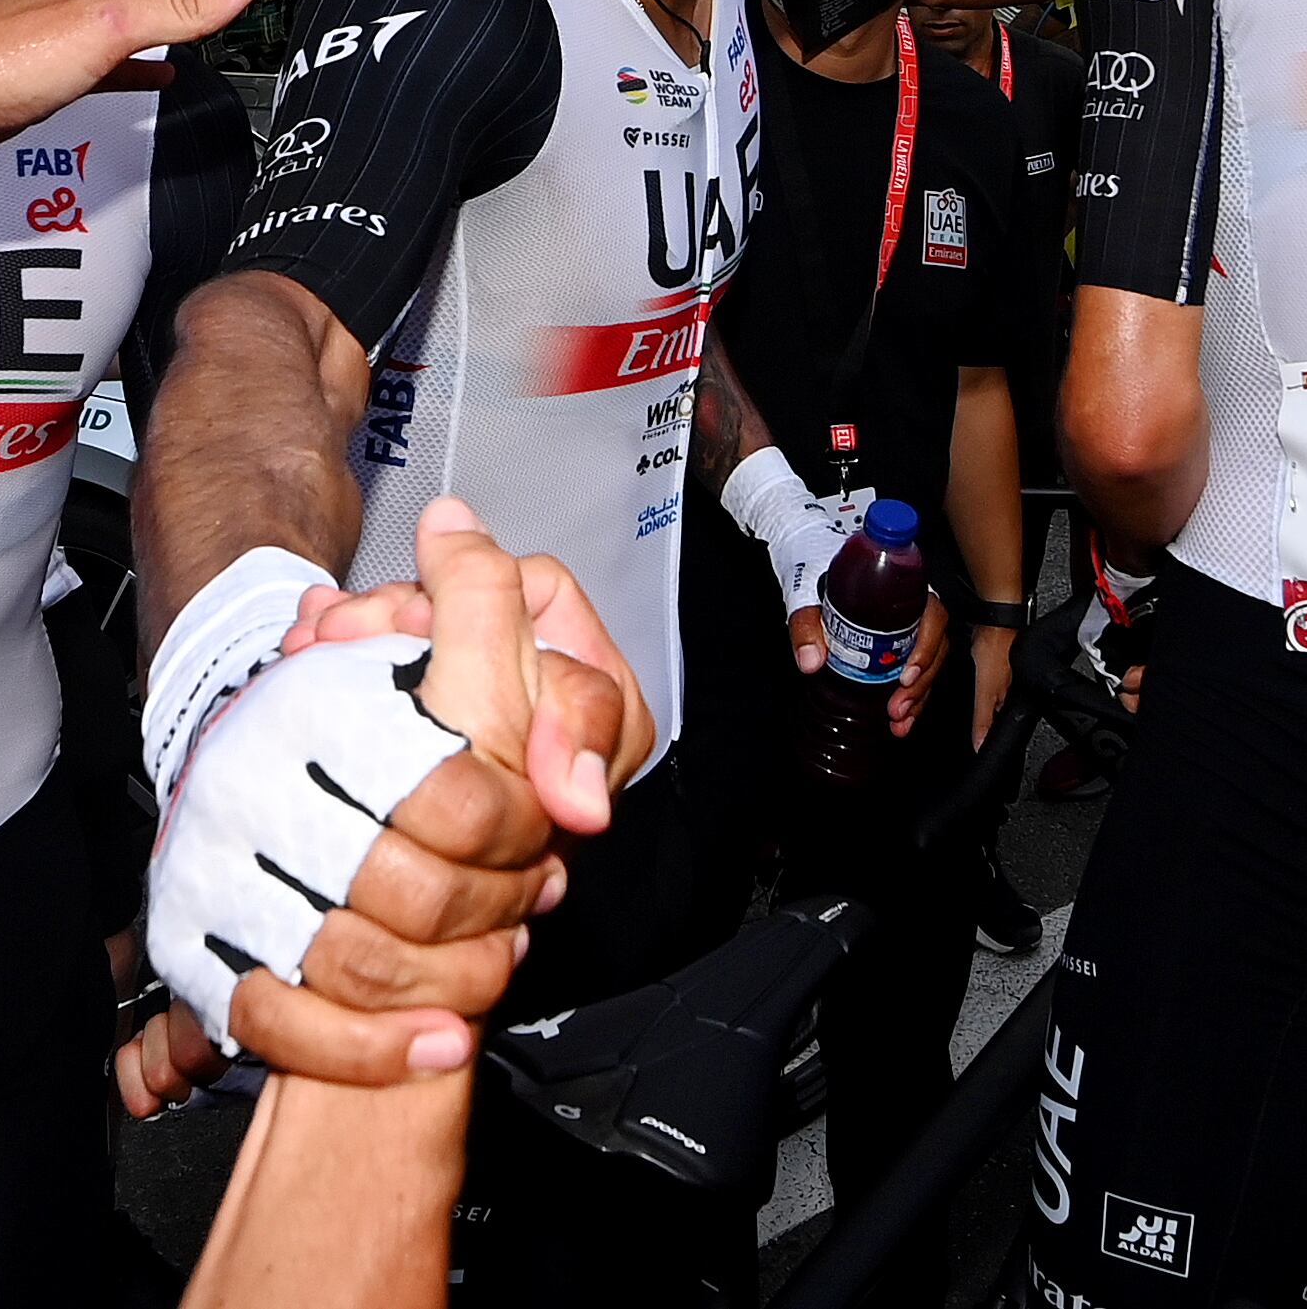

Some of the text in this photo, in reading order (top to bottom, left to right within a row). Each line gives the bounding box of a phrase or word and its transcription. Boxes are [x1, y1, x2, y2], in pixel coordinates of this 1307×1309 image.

[649, 69, 674, 83] UCI
[654, 83, 700, 97] WORLD
[657, 94, 691, 108] TEAM
[643, 132, 690, 148] PISSEI
[930, 212, 963, 233] UAE
[636, 511, 677, 541] ADNOC
[1032, 1025, 1085, 1225] UAE
[1117, 1240, 1174, 1264] ALDAR
